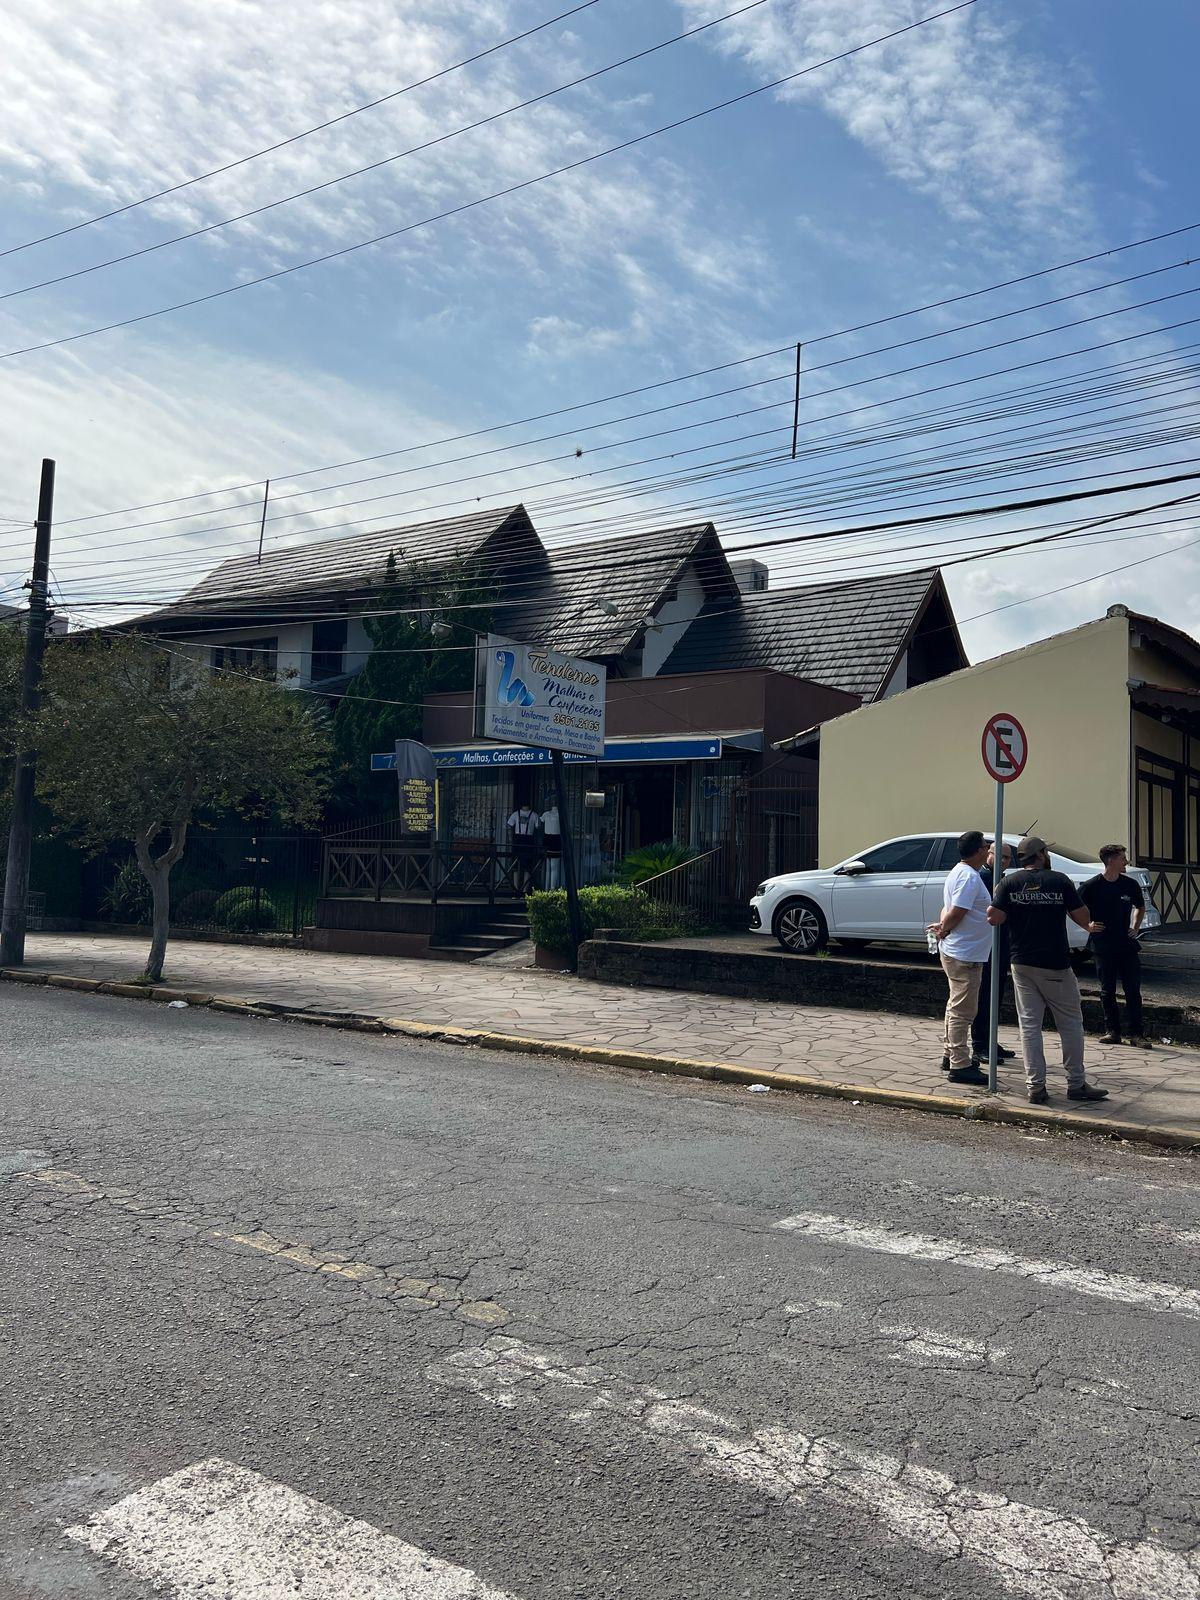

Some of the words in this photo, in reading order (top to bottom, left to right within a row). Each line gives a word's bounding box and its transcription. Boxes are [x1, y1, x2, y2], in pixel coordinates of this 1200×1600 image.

[542, 677, 586, 700] Malhas
[588, 694, 596, 702] e
[521, 709, 550, 722] Uniformes
[548, 694, 602, 718] Confecções
[492, 714, 514, 727] Tecidos
[514, 720, 524, 728] em
[525, 722, 541, 732] geral
[564, 728, 579, 738] Mesa
[584, 731, 601, 743] Banho
[493, 725, 528, 739] Aviamentos
[534, 731, 564, 744] Armarinho
[568, 738, 596, 752] Decoração
[462, 752, 491, 764] Malhas,
[492, 750, 534, 764] Confecções
[995, 726, 1013, 769] E
